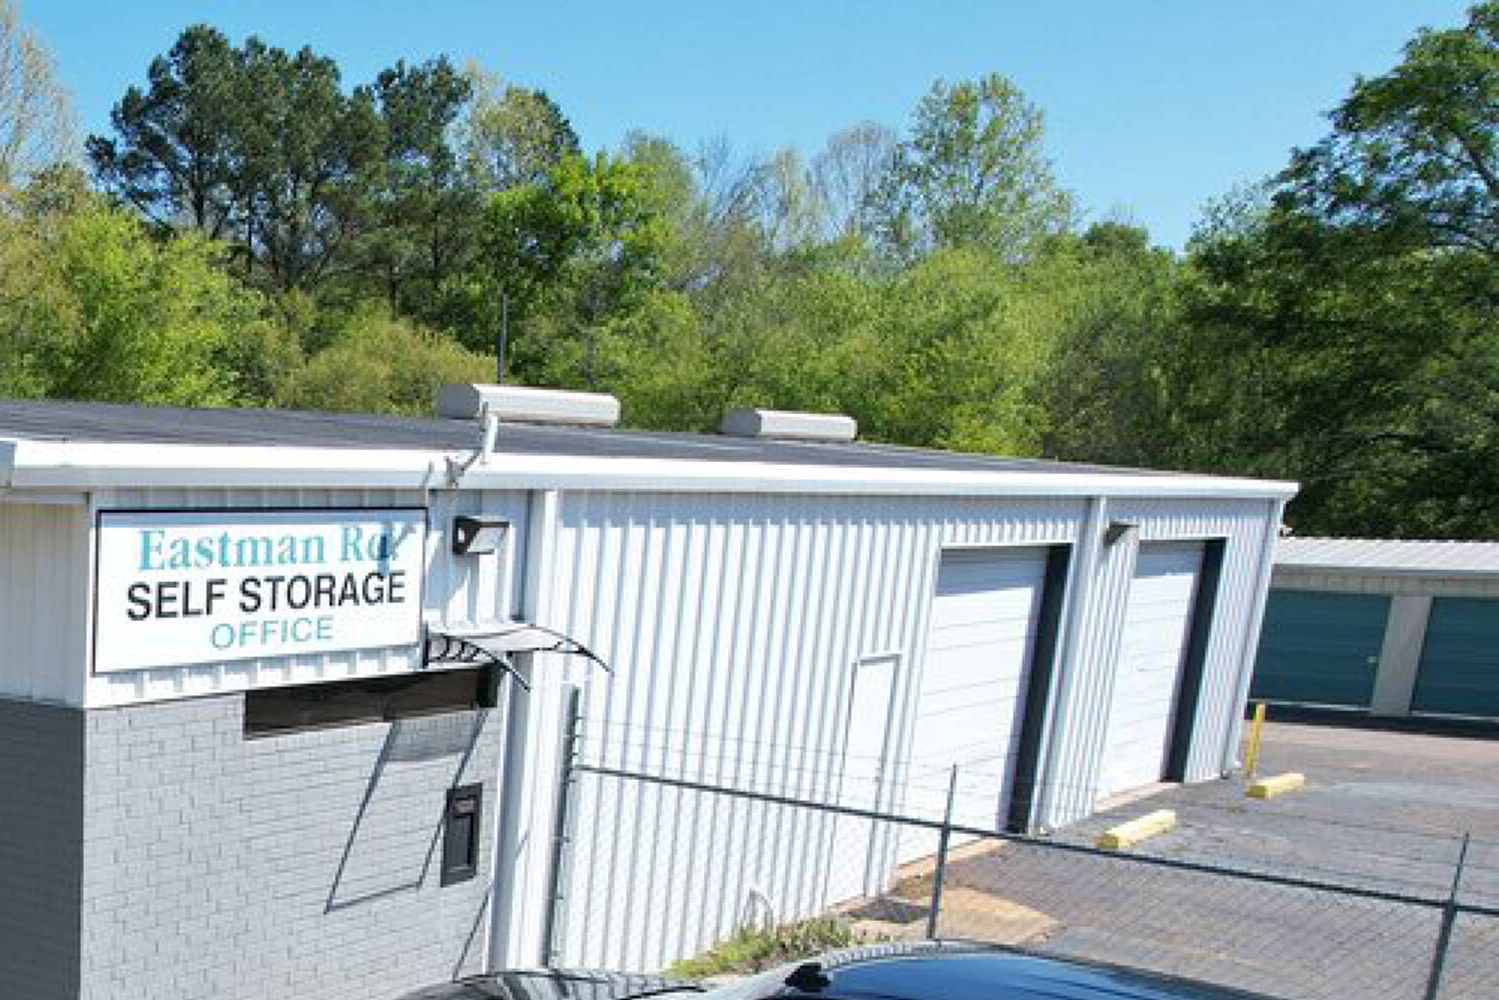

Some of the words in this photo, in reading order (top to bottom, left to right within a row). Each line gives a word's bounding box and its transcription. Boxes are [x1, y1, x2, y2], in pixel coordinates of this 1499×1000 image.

[139, 528, 326, 570] Eastman
[127, 578, 228, 621] SELF
[239, 569, 406, 612] STORAGE
[211, 615, 334, 649] OFFICE
